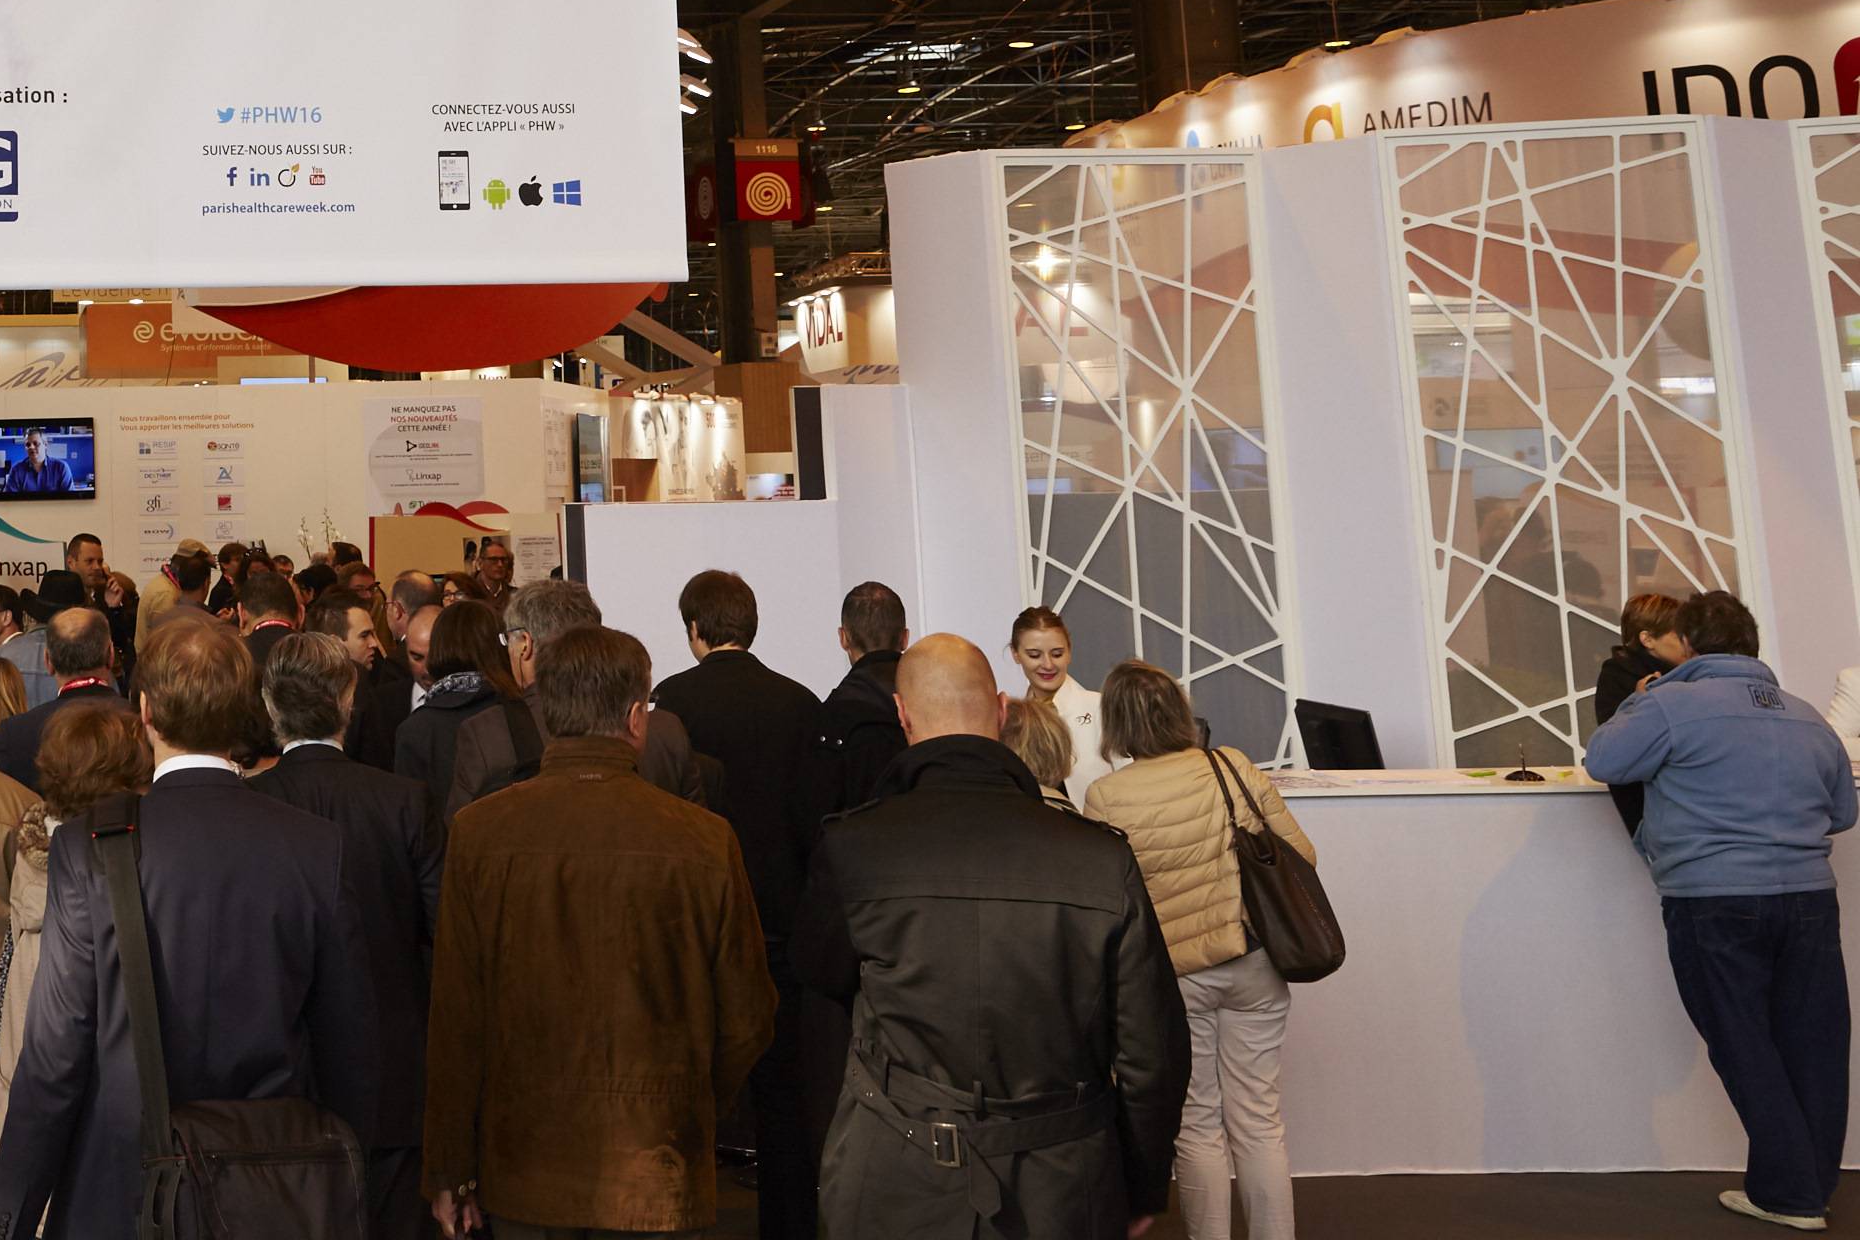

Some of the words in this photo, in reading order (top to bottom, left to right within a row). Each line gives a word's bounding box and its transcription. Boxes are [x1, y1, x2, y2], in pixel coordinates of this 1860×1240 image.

[432, 104, 539, 116] CONNECTEZ-VOUS
[542, 103, 575, 114] AUSSI
[240, 107, 322, 124] #PHW16
[444, 121, 474, 132] AVEC
[528, 121, 555, 131] PHW
[202, 144, 283, 156] SUIVEZ-NOUS
[286, 144, 320, 155] AUSSI
[322, 144, 347, 155] SUR
[202, 201, 355, 217] parishealthcareweek.com
[161, 344, 195, 352] Systèmes
[404, 406, 440, 414] MANQUEZ
[214, 414, 230, 422] pour
[407, 414, 457, 422] NOUVEAUTÉS
[139, 423, 170, 432] apporter
[422, 423, 447, 431] ANNÉE
[0, 561, 47, 583] nxap
